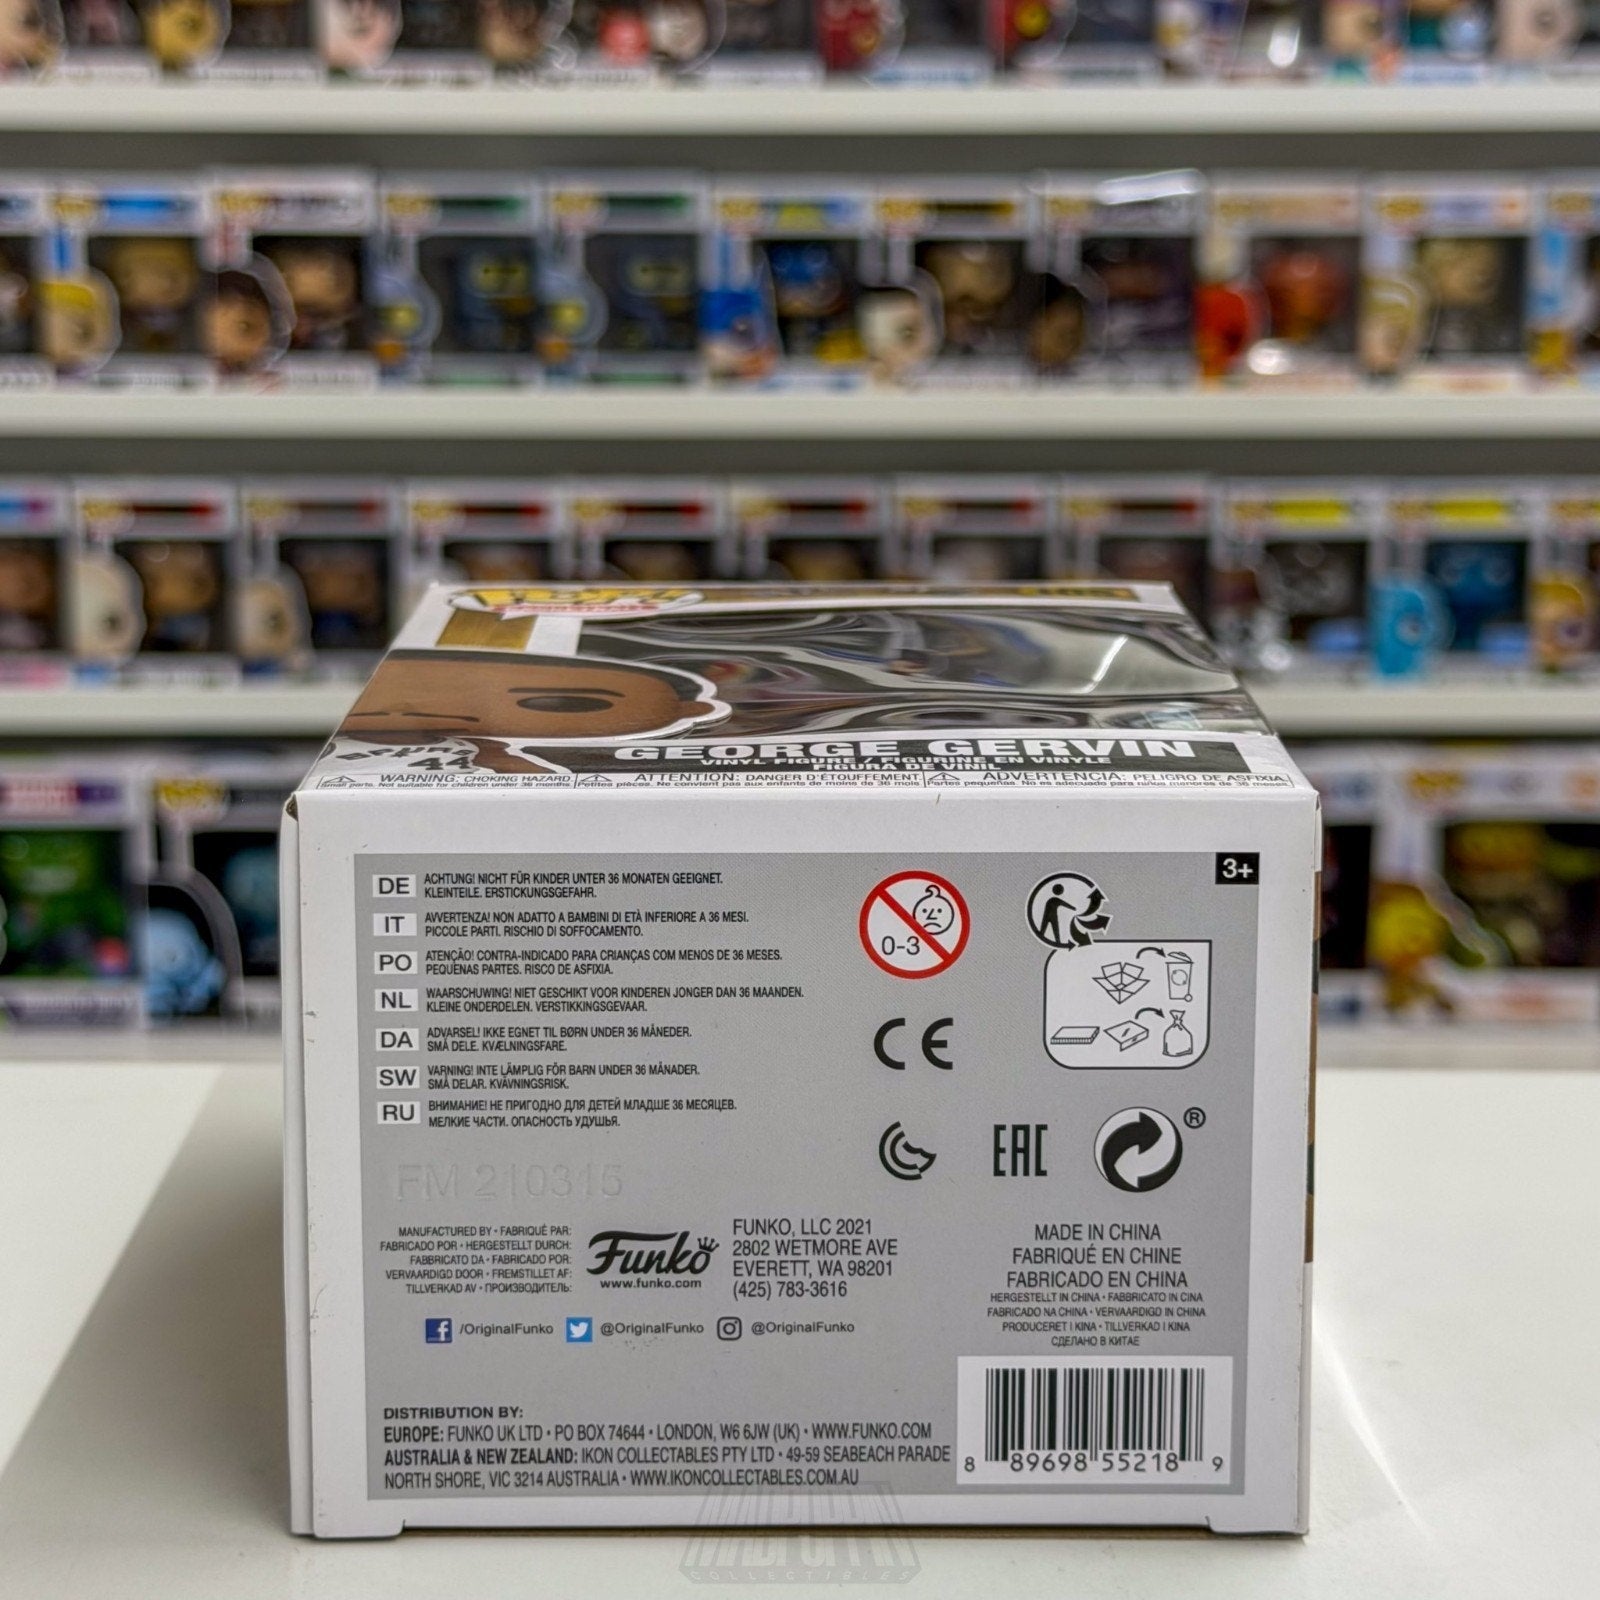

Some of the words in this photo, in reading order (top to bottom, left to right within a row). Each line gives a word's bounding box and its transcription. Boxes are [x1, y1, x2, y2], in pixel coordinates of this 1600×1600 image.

[614, 741, 900, 760] GEORGE
[927, 740, 1196, 757] GERVIN
[407, 757, 472, 770] 44
[380, 774, 459, 783] WARNING:
[464, 775, 518, 783] CHOKING
[634, 773, 740, 782] ATTENTION:
[983, 772, 1126, 781] ADVERTENCIA:
[1222, 859, 1253, 878] 3+
[378, 877, 410, 895] DE
[424, 873, 475, 884] ACHTUNG!
[478, 873, 508, 884] NICHT
[510, 871, 530, 884] FÜR
[533, 873, 570, 884] KINDER
[572, 873, 605, 884] UNTER
[608, 873, 619, 884] 36
[622, 873, 670, 884] MONATEN
[672, 873, 722, 884] GEEIGNET.
[424, 887, 482, 898] KLEINTEILE.
[485, 887, 597, 898] ERSTICKUNGSGEFAHR.
[384, 916, 405, 933] IT
[425, 912, 490, 923] AVVERTENZA!
[493, 912, 514, 923] NON
[518, 912, 556, 923] ADATTO
[558, 912, 565, 922] A
[568, 912, 609, 922] BAMBINI
[612, 912, 621, 922] DI
[625, 909, 642, 922] ETÀ
[645, 911, 696, 923] INFERIORE
[700, 912, 706, 922] A
[709, 912, 720, 922] 36
[722, 911, 748, 922] MESI.
[425, 926, 468, 937] PICCOLE
[470, 926, 501, 936] PARTI.
[504, 926, 544, 937] RISCHIO
[547, 926, 557, 936] DI
[559, 926, 643, 936] SOFFOCAMENTO.
[881, 936, 921, 955] 0-3
[379, 954, 413, 971] PO
[381, 992, 412, 1009] NL
[380, 1031, 413, 1048] DA
[379, 1069, 417, 1086] SW
[382, 1104, 415, 1121] RU
[428, 1100, 488, 1111] ВНИМАНИЕ!
[490, 1100, 503, 1110] НЕ
[506, 1100, 562, 1113] ПРИГОДНО
[564, 1100, 586, 1112] ДЛЯ
[588, 1097, 621, 1112] ДЕТЕЙ
[624, 1099, 670, 1112] МЛАДШЕ
[672, 1099, 684, 1110] 36
[686, 1099, 737, 1112] МЕСЯЦЕВ.
[428, 1116, 470, 1127] МЕЛКИЕ
[472, 1116, 508, 1127] ЧАСТИ.
[510, 1116, 573, 1127] ОПАСНОСТЬ
[575, 1116, 620, 1128] УДУШЬЯ.
[993, 1124, 1048, 1176] EAC
[397, 1164, 458, 1200] FM
[474, 1163, 623, 1199] 210315
[398, 1226, 477, 1237] MANUFACTURED
[479, 1226, 492, 1236] BY
[500, 1224, 548, 1236] FABRIQUÉ
[550, 1226, 571, 1235] PAR:
[733, 1218, 795, 1237] FUNKO,
[801, 1218, 831, 1235] LLC
[836, 1218, 871, 1235] 2021
[1034, 1224, 1083, 1241] MADE
[1088, 1224, 1104, 1240] IN
[1109, 1223, 1162, 1240] CHINA
[586, 1230, 712, 1275] Funko
[732, 1240, 770, 1256] 2802
[775, 1238, 862, 1256] WETMORE
[866, 1239, 898, 1255] AVE
[1013, 1244, 1096, 1265] FABRIQUÉ
[1102, 1248, 1125, 1264] EN
[1130, 1247, 1182, 1264] CHINE
[733, 1260, 812, 1278] EVERETT,
[817, 1260, 844, 1276] WA
[847, 1260, 891, 1276] 98201
[600, 1278, 702, 1289] www.funko.com
[1007, 1271, 1103, 1288] FABRICADO
[1108, 1271, 1130, 1287] EN
[1136, 1271, 1188, 1288] CHINA
[733, 1281, 772, 1301] (425)
[778, 1280, 847, 1297] 783-3616
[459, 1323, 554, 1337] /OriginalFunko
[600, 1322, 705, 1336] @OriginalFunko
[751, 1321, 855, 1335] @OriginalFunko
[1051, 1336, 1098, 1347] СДЕЛАНО
[1100, 1336, 1106, 1346] В
[1108, 1336, 1140, 1346] КИТАЕ
[384, 1407, 494, 1420] DISTRIBUTION
[498, 1406, 523, 1418] BY:
[384, 1426, 444, 1443] EUROPE:
[447, 1425, 494, 1442] FUNKO
[497, 1425, 516, 1441] UK
[518, 1425, 543, 1441] LTD
[554, 1424, 574, 1441] PO
[577, 1424, 605, 1441] BOX
[608, 1425, 645, 1441] 74644
[657, 1423, 716, 1442] LONDON,
[720, 1424, 740, 1440] W6
[743, 1424, 770, 1440] 6JW
[773, 1423, 800, 1442] (UK)
[812, 1422, 932, 1440] WWW.FUNKO.COM
[384, 1449, 460, 1466] AUSTRALIA
[464, 1449, 472, 1465] &
[476, 1448, 507, 1465] NEW
[510, 1448, 578, 1464] ZEALAND:
[582, 1447, 613, 1464] IKON
[616, 1446, 718, 1464] COLLECTABLES
[722, 1446, 747, 1462] PTY
[751, 1446, 774, 1462] LTD
[786, 1447, 820, 1462] 49-59
[824, 1445, 894, 1462] SEABEACH
[898, 1445, 950, 1462] PARADE
[964, 1456, 975, 1472] 8
[1010, 1453, 1087, 1472] 89698
[1102, 1453, 1178, 1472] 55218
[1212, 1456, 1223, 1472] 9
[384, 1472, 431, 1489] NORTH
[434, 1471, 485, 1489] SHORE,
[488, 1471, 510, 1488] VIC
[514, 1471, 544, 1487] 3214
[546, 1470, 620, 1487] AUSTRALIA
[630, 1468, 859, 1487] WWW.IKONCOLLECTABLES.COM.AU
